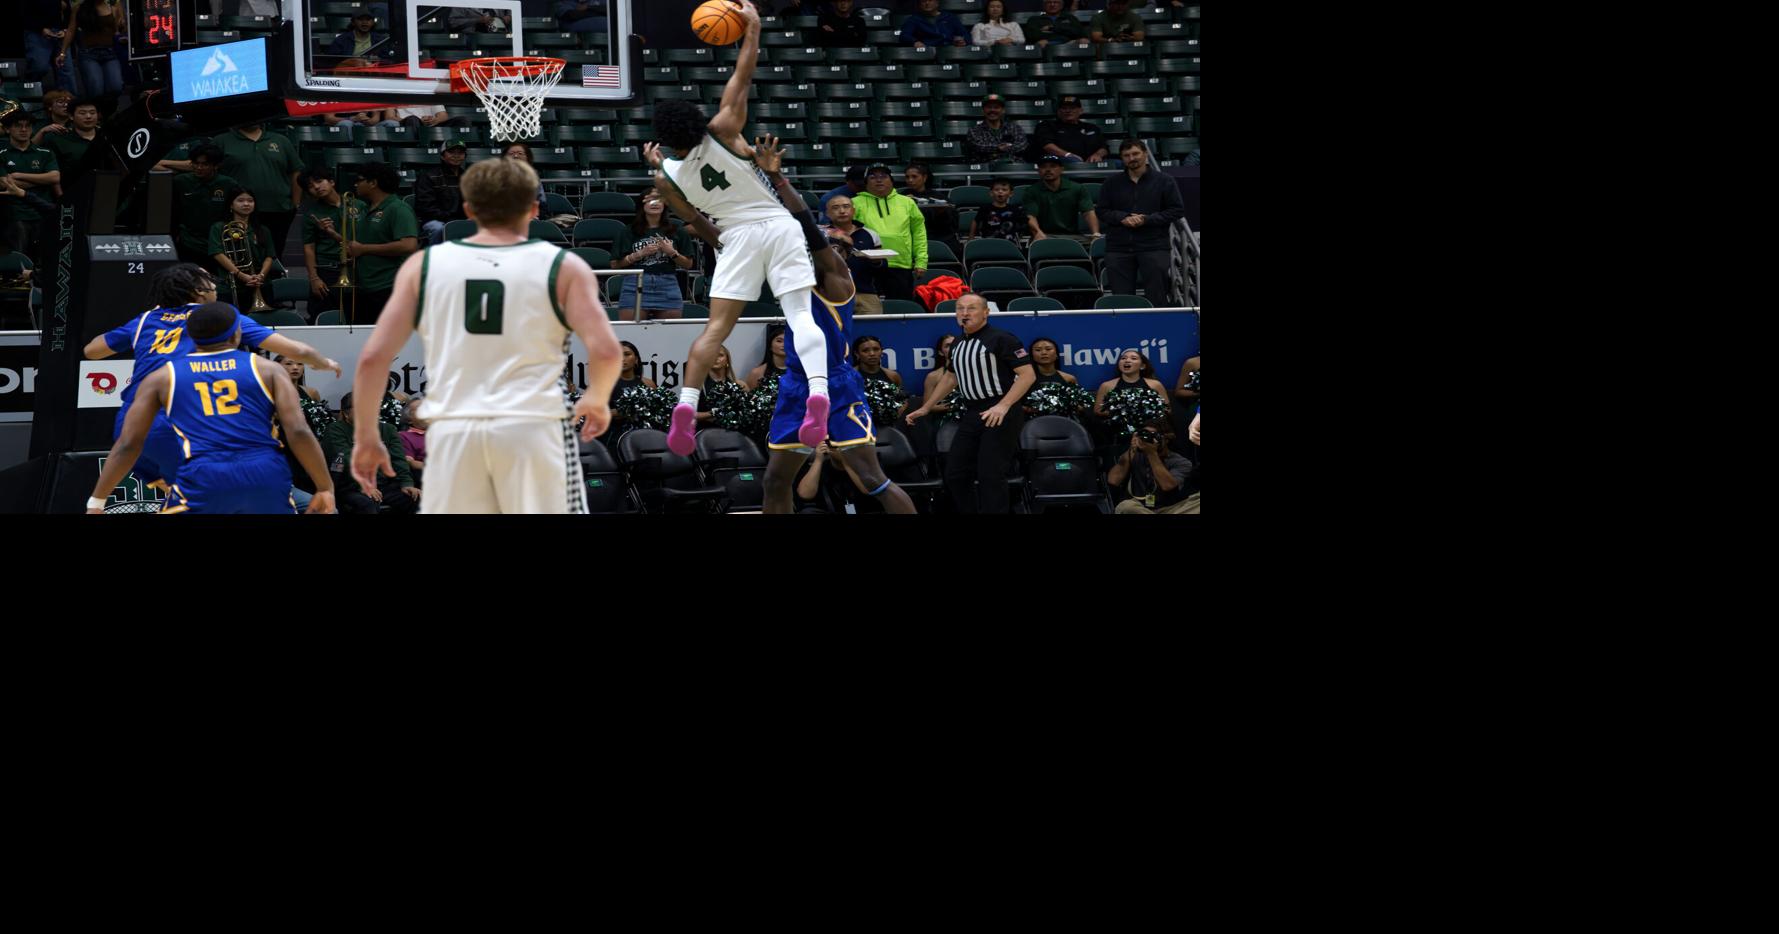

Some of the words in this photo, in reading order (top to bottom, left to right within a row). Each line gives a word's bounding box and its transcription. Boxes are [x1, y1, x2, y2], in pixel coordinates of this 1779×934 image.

[148, 15, 174, 44] 24
[305, 79, 340, 88] SPALDING
[700, 163, 732, 192] 4
[128, 262, 145, 274] 24
[465, 279, 505, 335] 0
[150, 327, 183, 354] 10
[189, 359, 237, 373] WALLER
[194, 379, 241, 417] 12
